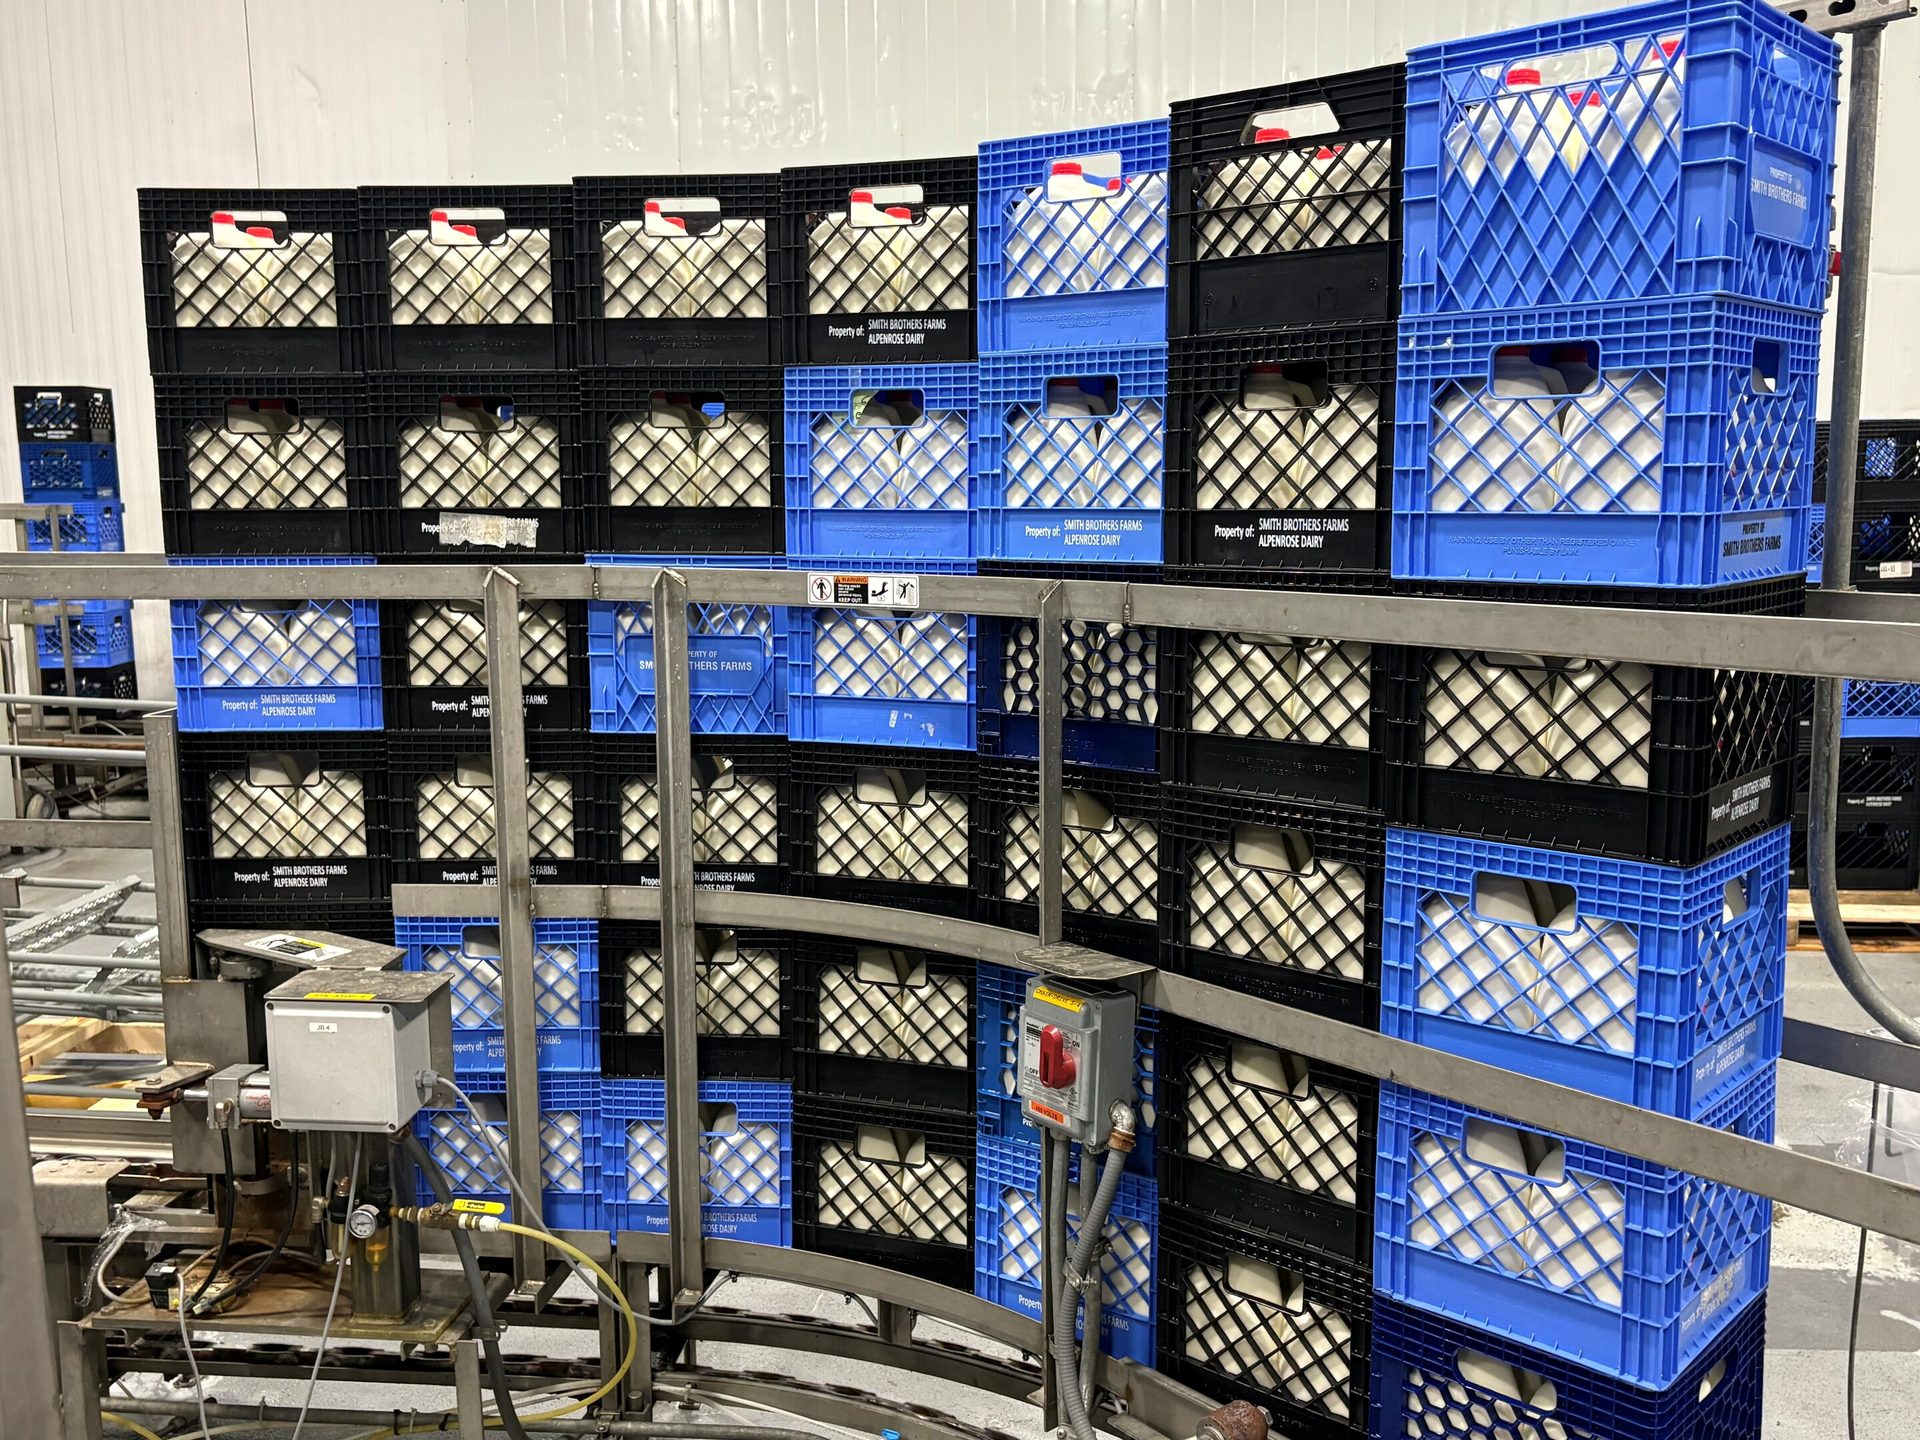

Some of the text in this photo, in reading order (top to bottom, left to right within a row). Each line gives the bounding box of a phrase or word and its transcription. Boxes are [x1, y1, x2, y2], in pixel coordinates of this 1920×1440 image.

[1751, 178, 1807, 210] SMITH BROTHERS FARMS
[868, 319, 947, 329] SMITH BROTHERS FARMS
[828, 325, 864, 338] Property of:
[868, 333, 925, 344] ALPENROSE DAIRY
[1064, 520, 1142, 531] SMITH BROTHERS FARMS
[1259, 518, 1349, 532] SMITH BROTHERS FARMS
[1026, 525, 1060, 538] Property of:
[1214, 524, 1254, 540] Property of:
[1064, 534, 1121, 545] ALPENROSE DAIRY
[1258, 534, 1324, 548] ALPENROSE DAIRY
[1512, 537, 1536, 545] OTHER
[1723, 534, 1781, 557] SMITH BROTHERS FARMS
[689, 661, 752, 671] THERS FARMS
[260, 694, 336, 704] SMITH BROTHERS FARMS
[526, 695, 548, 704] FARMS
[222, 699, 258, 711] Property of:
[432, 700, 468, 712] Property of:
[262, 706, 316, 716] ALPENROSE DAIRY
[472, 708, 490, 717] ALPEN
[272, 866, 347, 876] SMITH BROTHERS FARMS
[482, 866, 557, 875] SMIT FARMS
[234, 871, 270, 883] Property of:
[442, 871, 469, 883] Property
[470, 870, 479, 880] of:
[641, 876, 660, 887] Prope
[701, 872, 732, 882] BROTHERS
[734, 872, 755, 882] FARMS
[274, 878, 328, 887] ALPENROSE DAIRY
[540, 1035, 561, 1044] FARMS
[1072, 1040, 1080, 1048] ON
[453, 1041, 484, 1053] roperty of:
[1029, 1067, 1038, 1076] OFF
[646, 1216, 669, 1226] Propert
[704, 1213, 757, 1222] BROTHERS FARMS
[720, 1225, 737, 1233] DAIRY
[1108, 1316, 1129, 1330] FARMS
